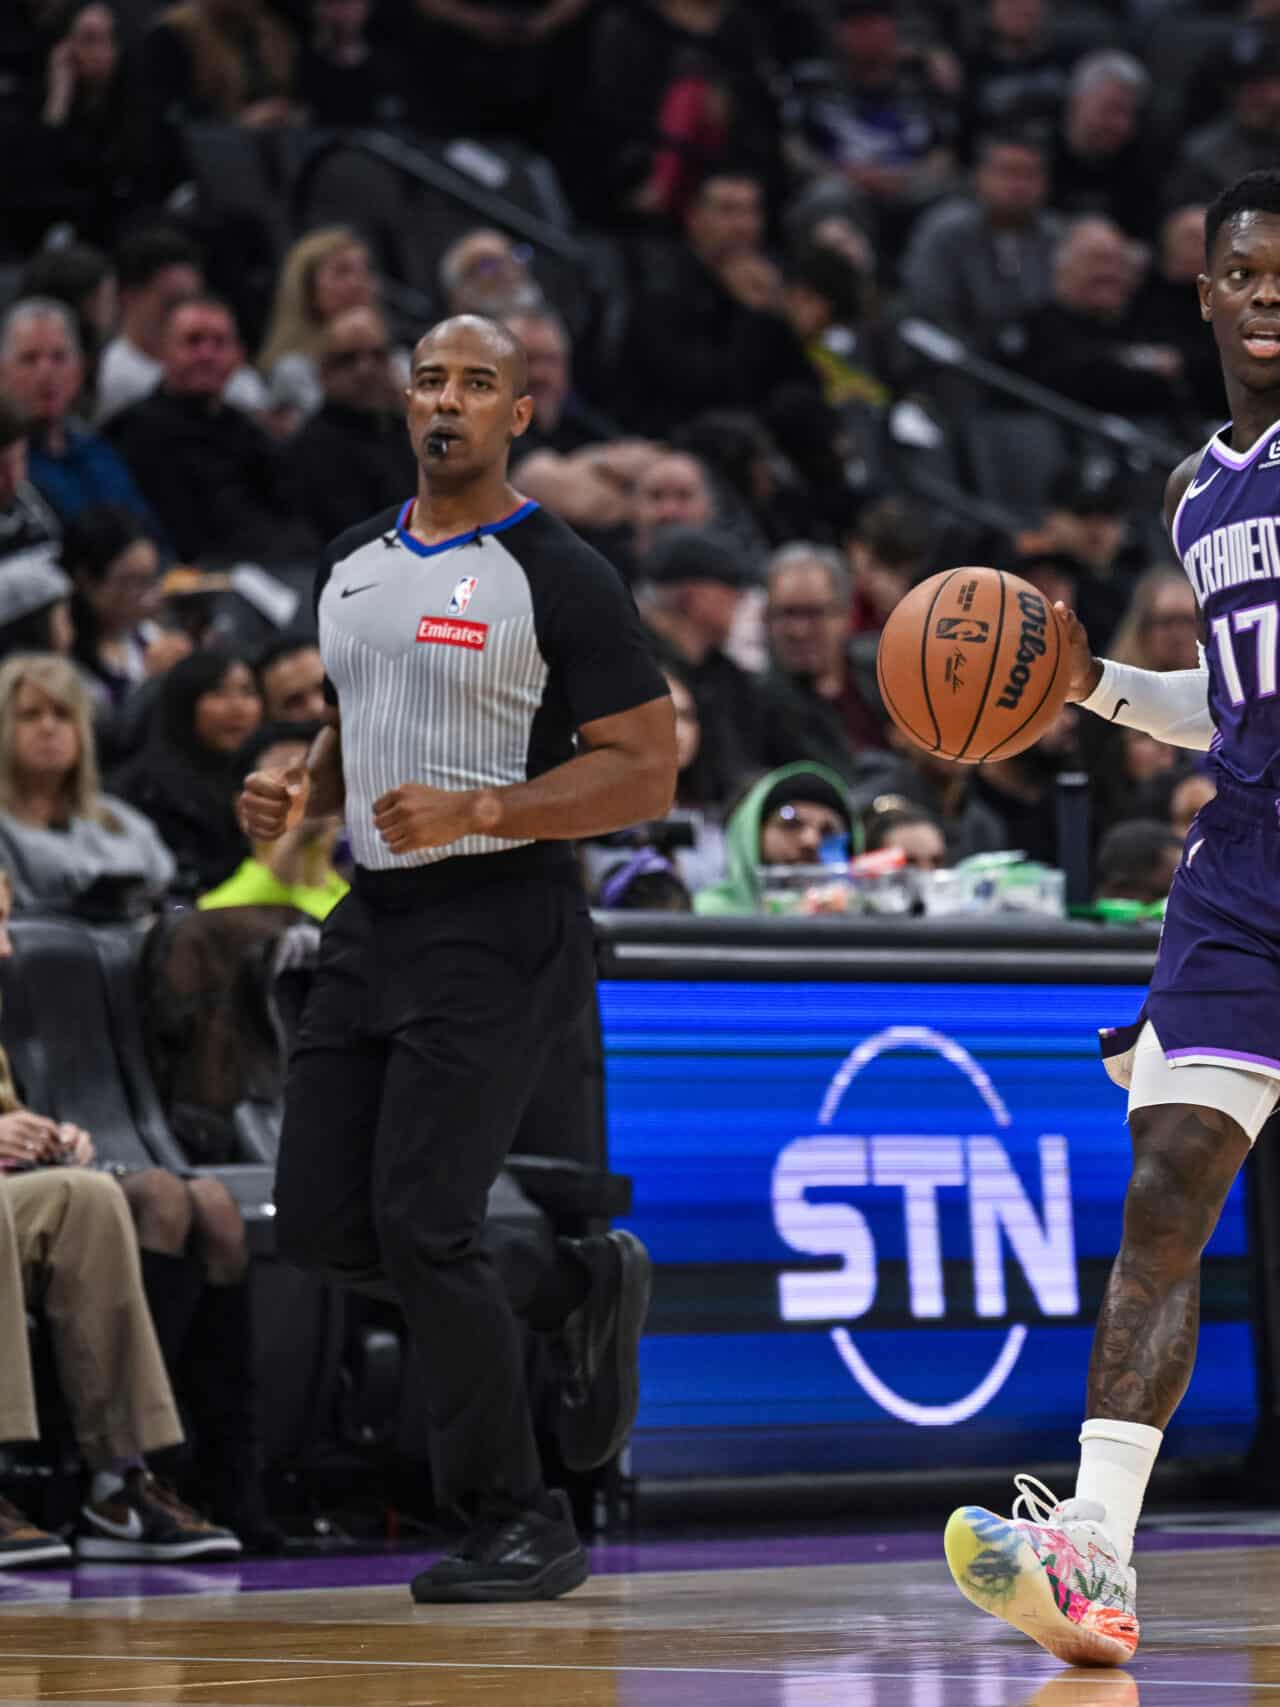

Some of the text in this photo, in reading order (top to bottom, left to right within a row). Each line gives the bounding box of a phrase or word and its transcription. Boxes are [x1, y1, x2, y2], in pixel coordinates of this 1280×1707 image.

[419, 620, 484, 644] Emirates
[996, 591, 1047, 710] Wilson
[1211, 601, 1279, 706] 17
[771, 1134, 1080, 1321] STN
